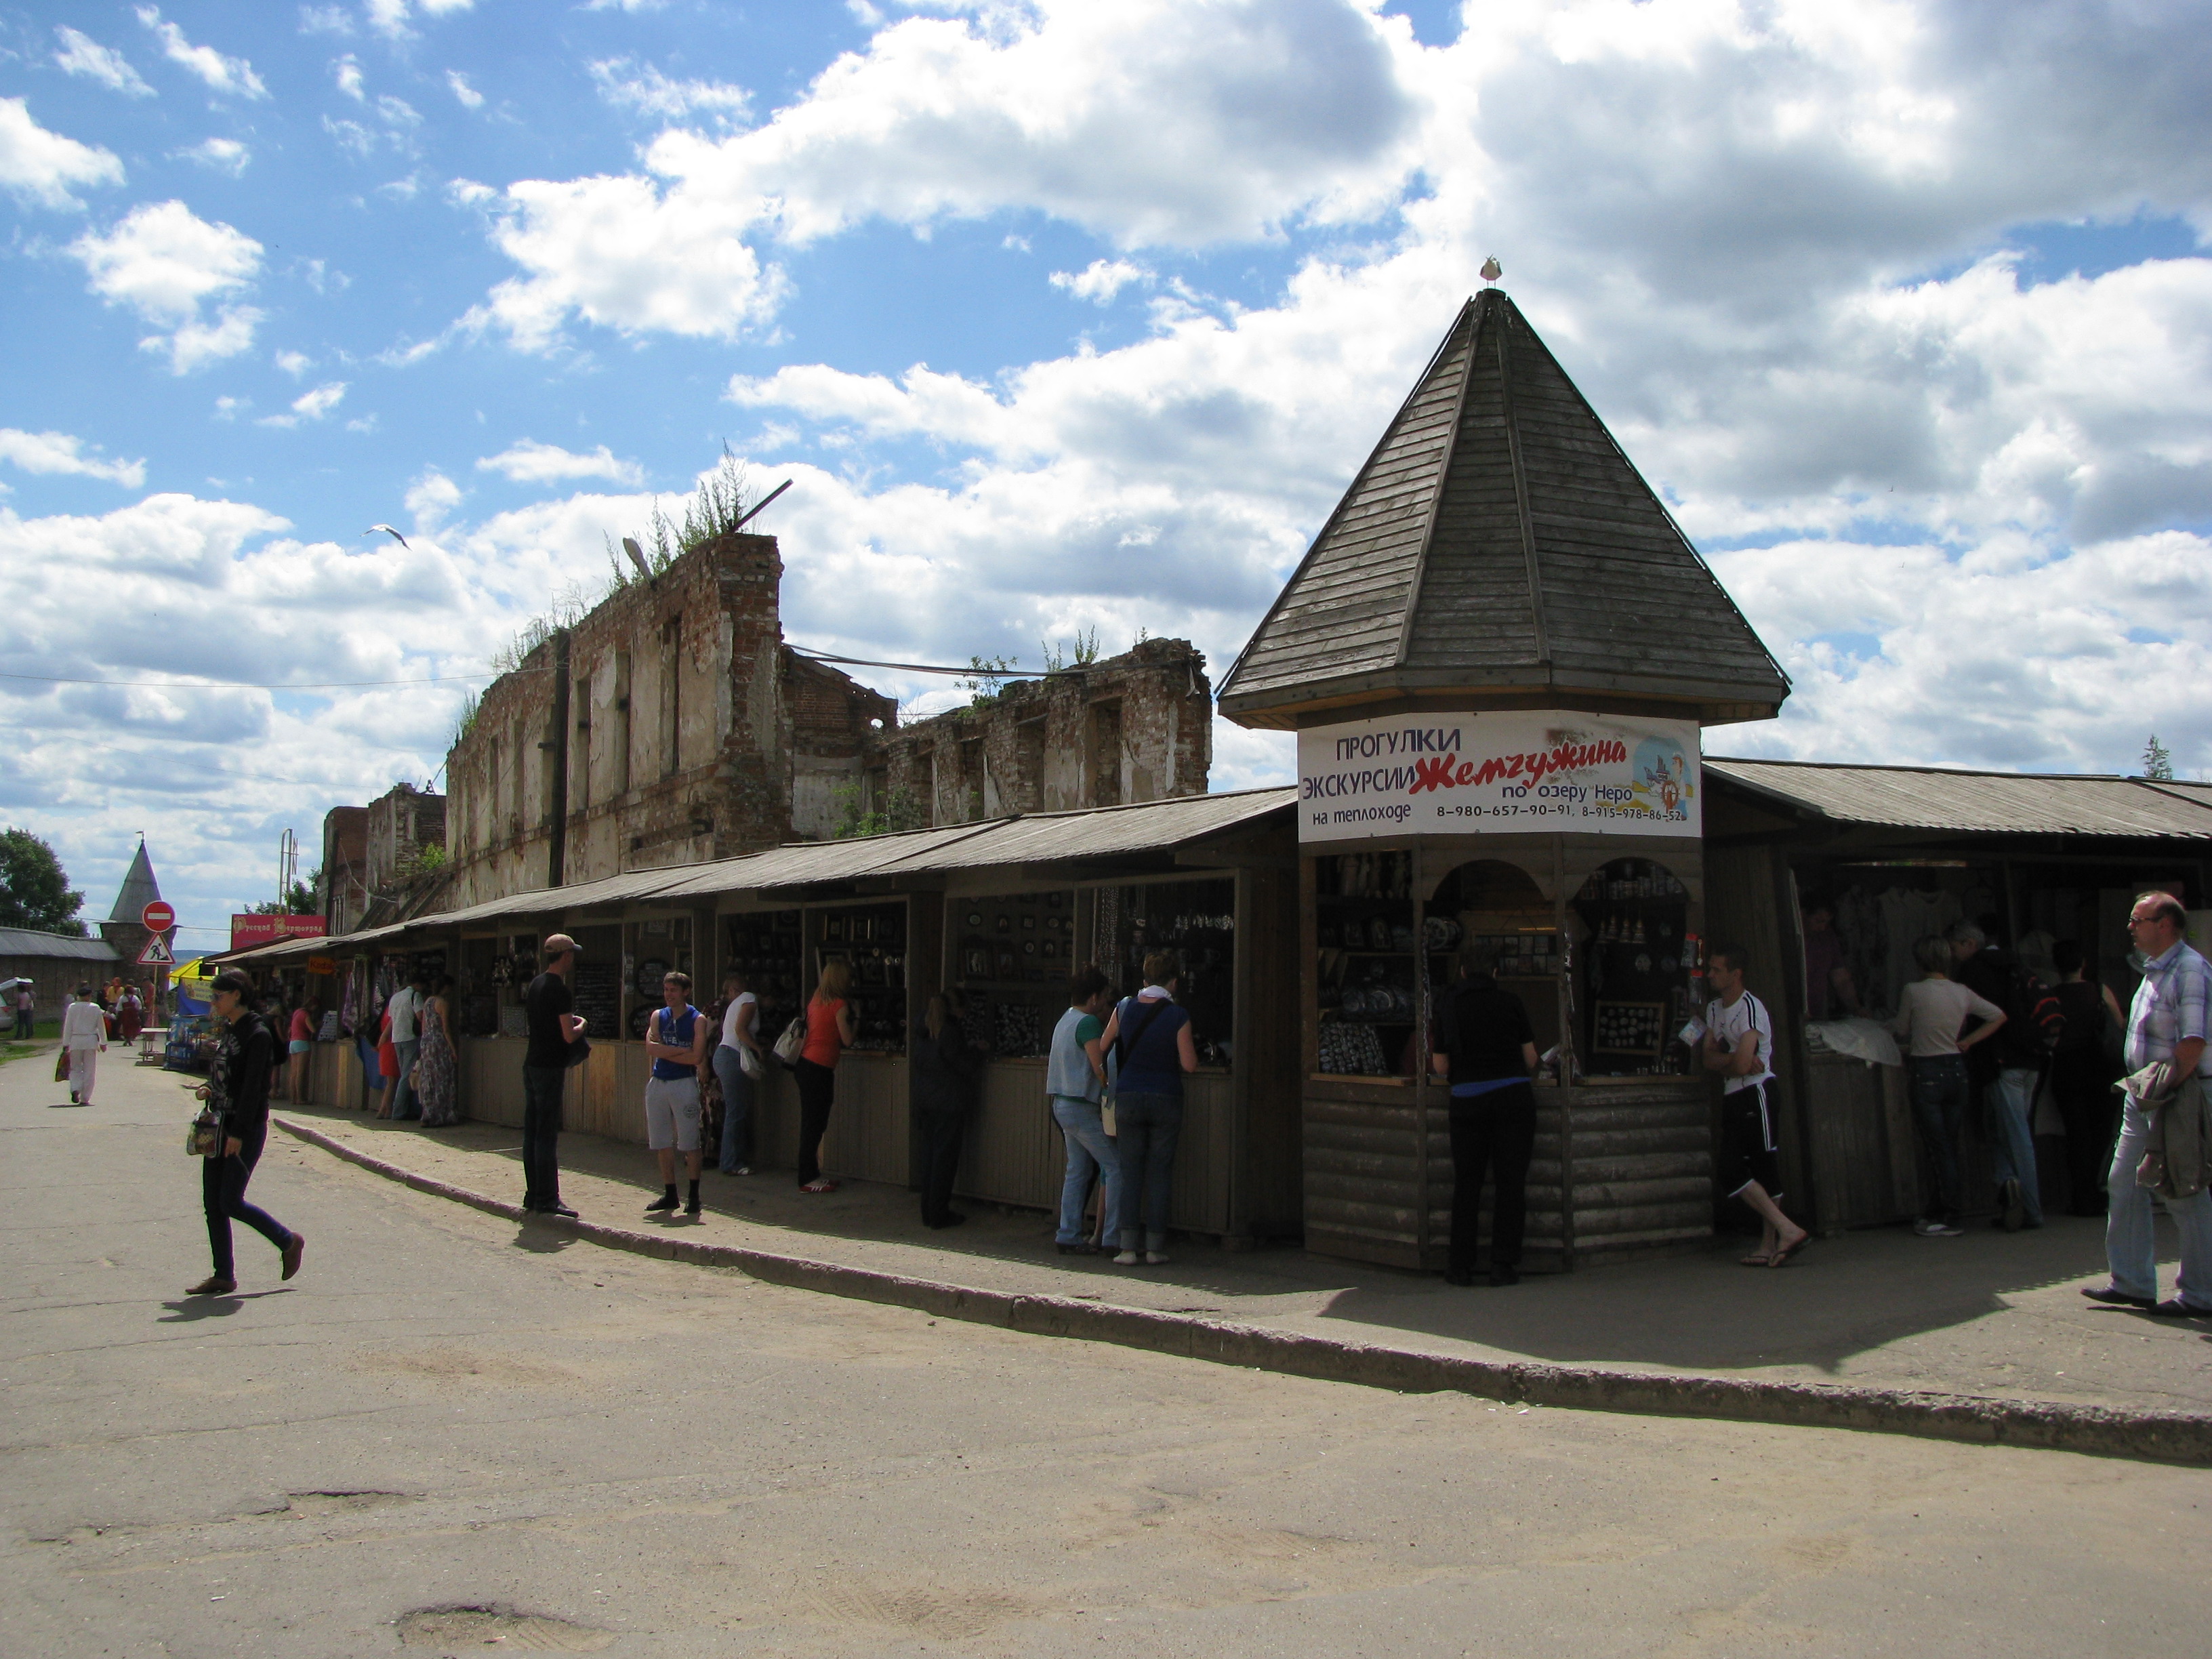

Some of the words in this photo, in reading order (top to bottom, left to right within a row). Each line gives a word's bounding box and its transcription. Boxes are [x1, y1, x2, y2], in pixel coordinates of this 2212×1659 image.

[1336, 729, 1461, 761] ПРОГУЛКИ
[1408, 739, 1627, 795] Жемчужина
[1303, 766, 1416, 800] ЭКСКУРСИИ
[1502, 785, 1528, 798] по
[1537, 785, 1587, 803] озеру
[1595, 784, 1633, 804] Неро
[1313, 811, 1328, 825] на
[1334, 804, 1412, 823] теплоходе
[1582, 806, 1681, 821] 8-915-978-86-52
